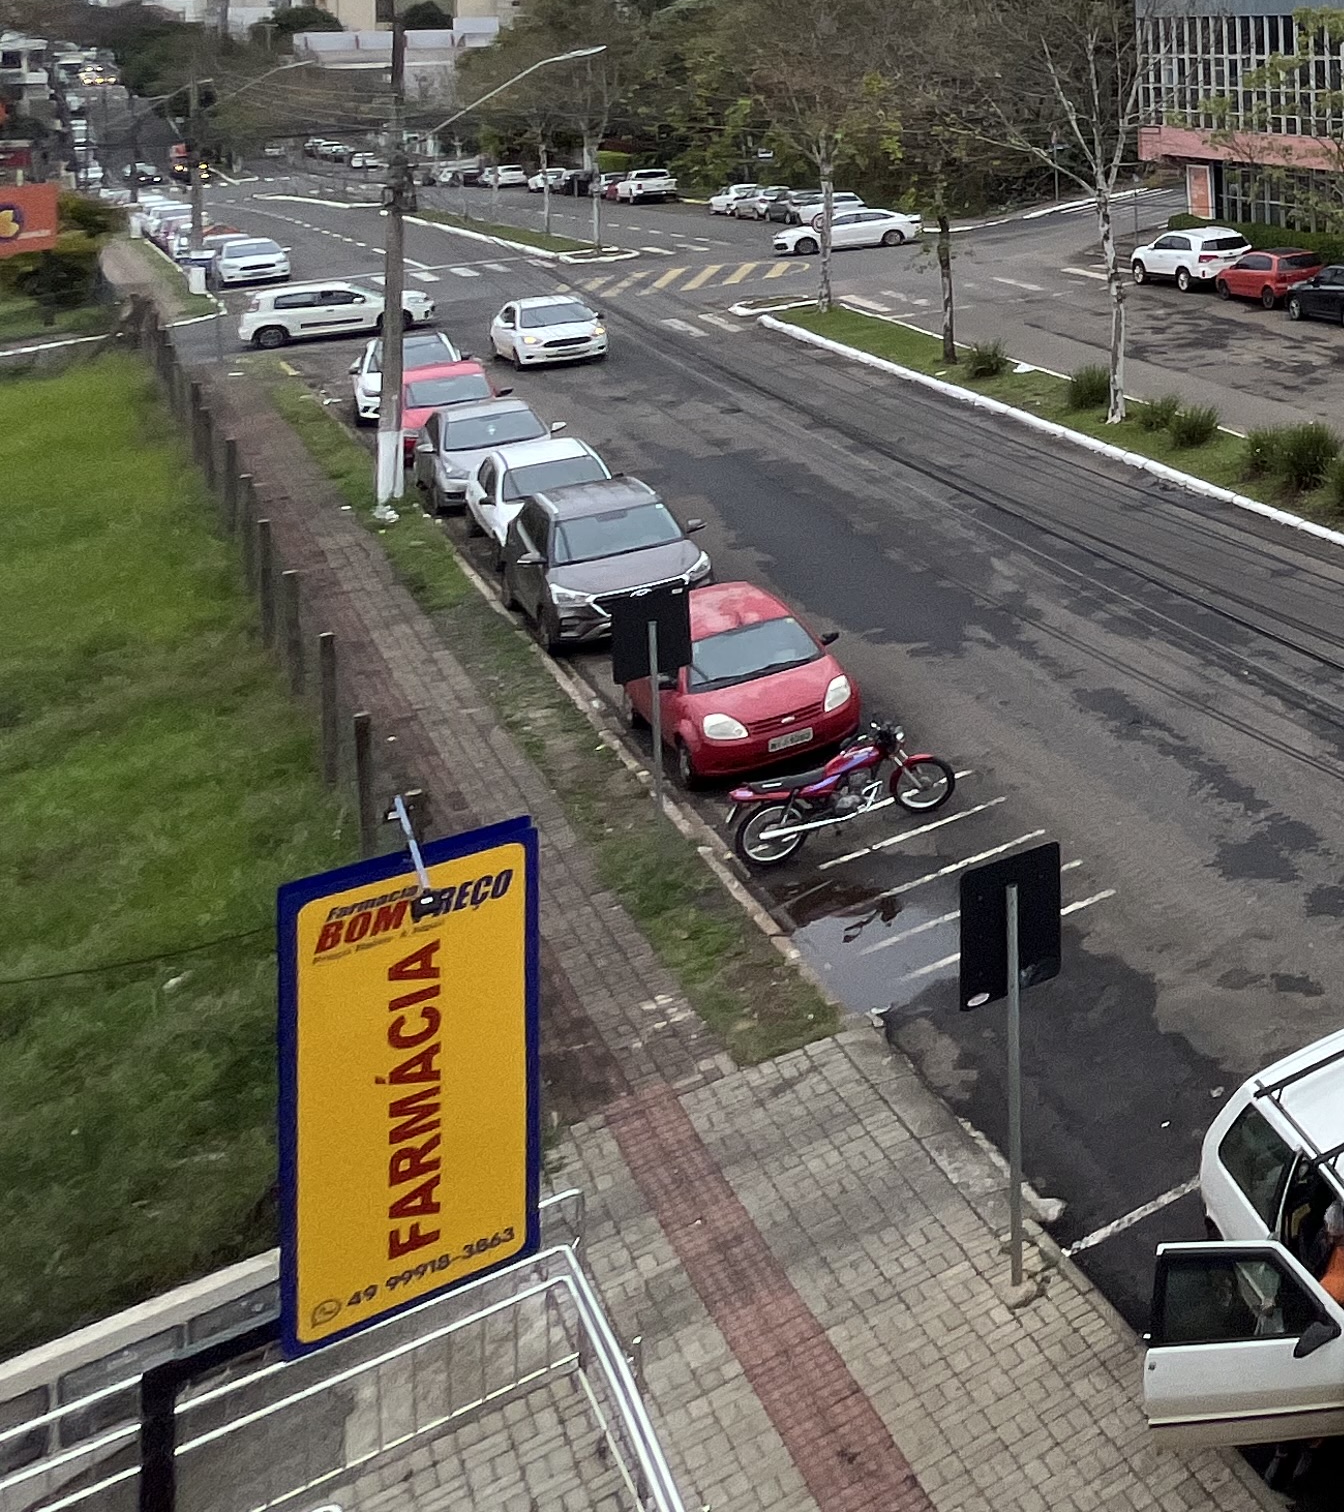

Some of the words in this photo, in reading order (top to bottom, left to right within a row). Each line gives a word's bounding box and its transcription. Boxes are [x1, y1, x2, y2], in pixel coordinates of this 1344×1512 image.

[314, 899, 410, 954] BOM
[410, 868, 514, 924] REÇO
[375, 938, 441, 1260] FARMÁCIA
[346, 1284, 379, 1307] 49
